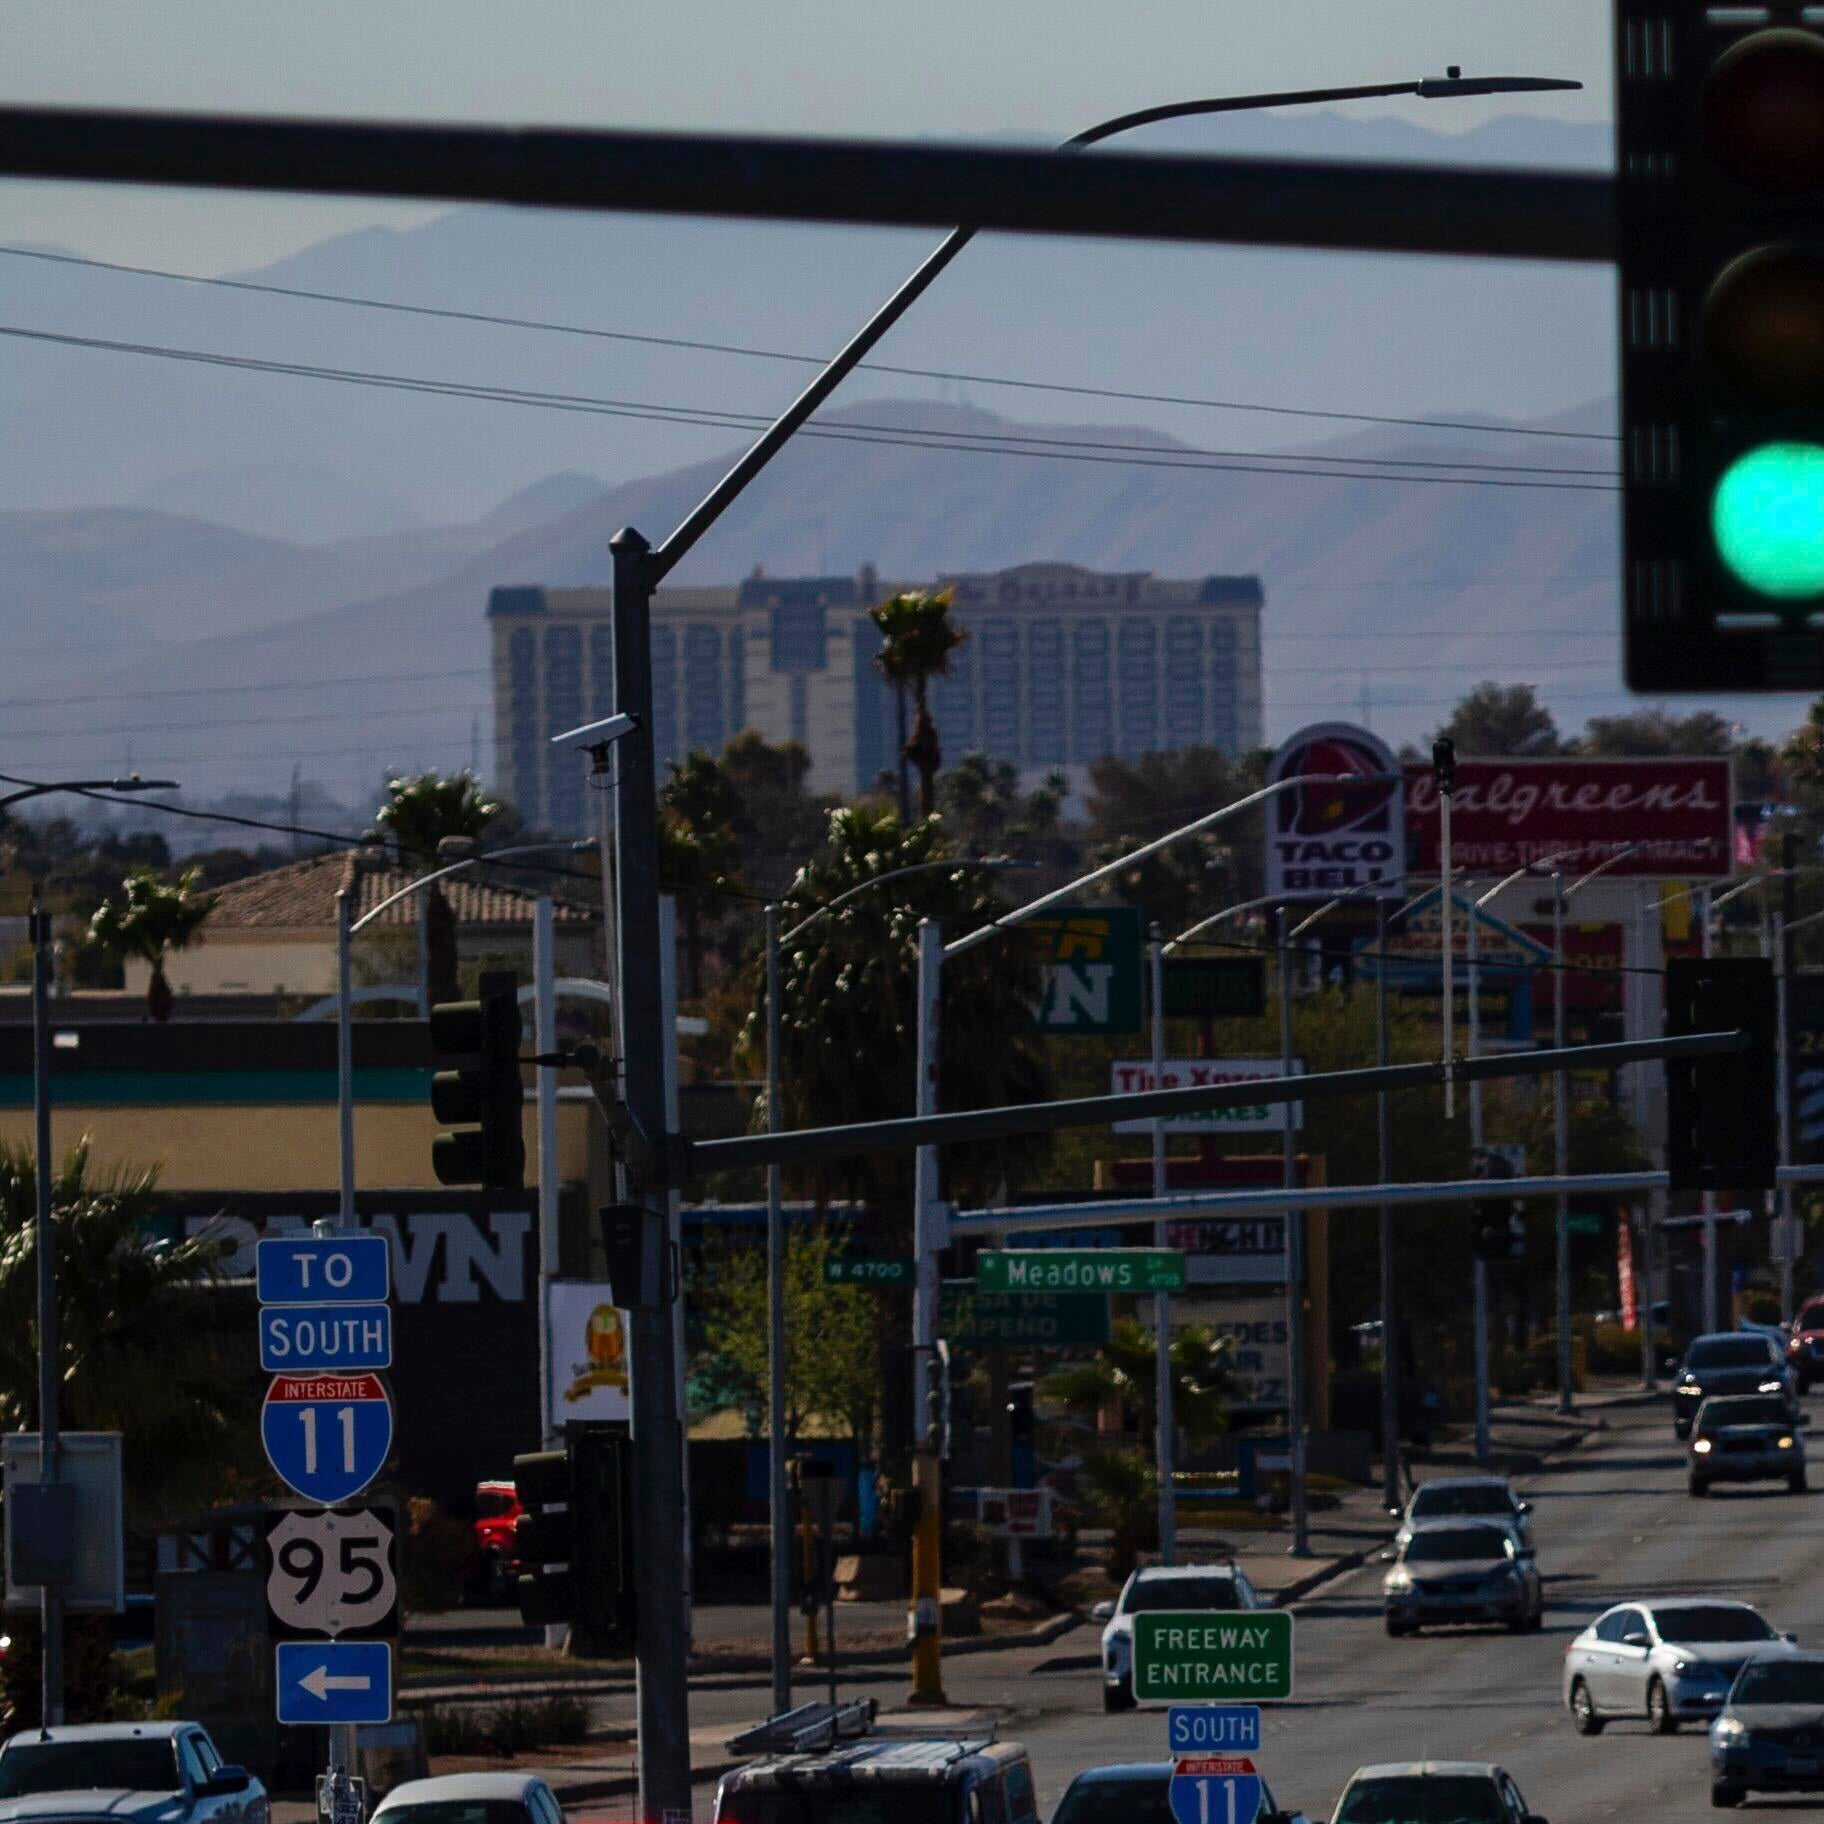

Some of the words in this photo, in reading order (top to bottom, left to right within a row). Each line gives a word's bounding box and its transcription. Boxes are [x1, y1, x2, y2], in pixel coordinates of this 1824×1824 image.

[1276, 840, 1392, 863] TACO
[1283, 866, 1395, 891] BELL
[292, 1252, 354, 1289] TO
[850, 1261, 903, 1280] 4700
[1007, 1257, 1133, 1287] Meadows
[268, 1318, 384, 1357] SOUTH
[283, 1380, 367, 1399] INTERSTATE
[298, 1406, 355, 1475] 11
[277, 1536, 385, 1605] 95
[1153, 1627, 1271, 1650] FREEWAY
[1146, 1662, 1280, 1685] ENTRANCE
[1174, 1713, 1256, 1743] SOUTH
[1184, 1760, 1247, 1775] INTERSTATE
